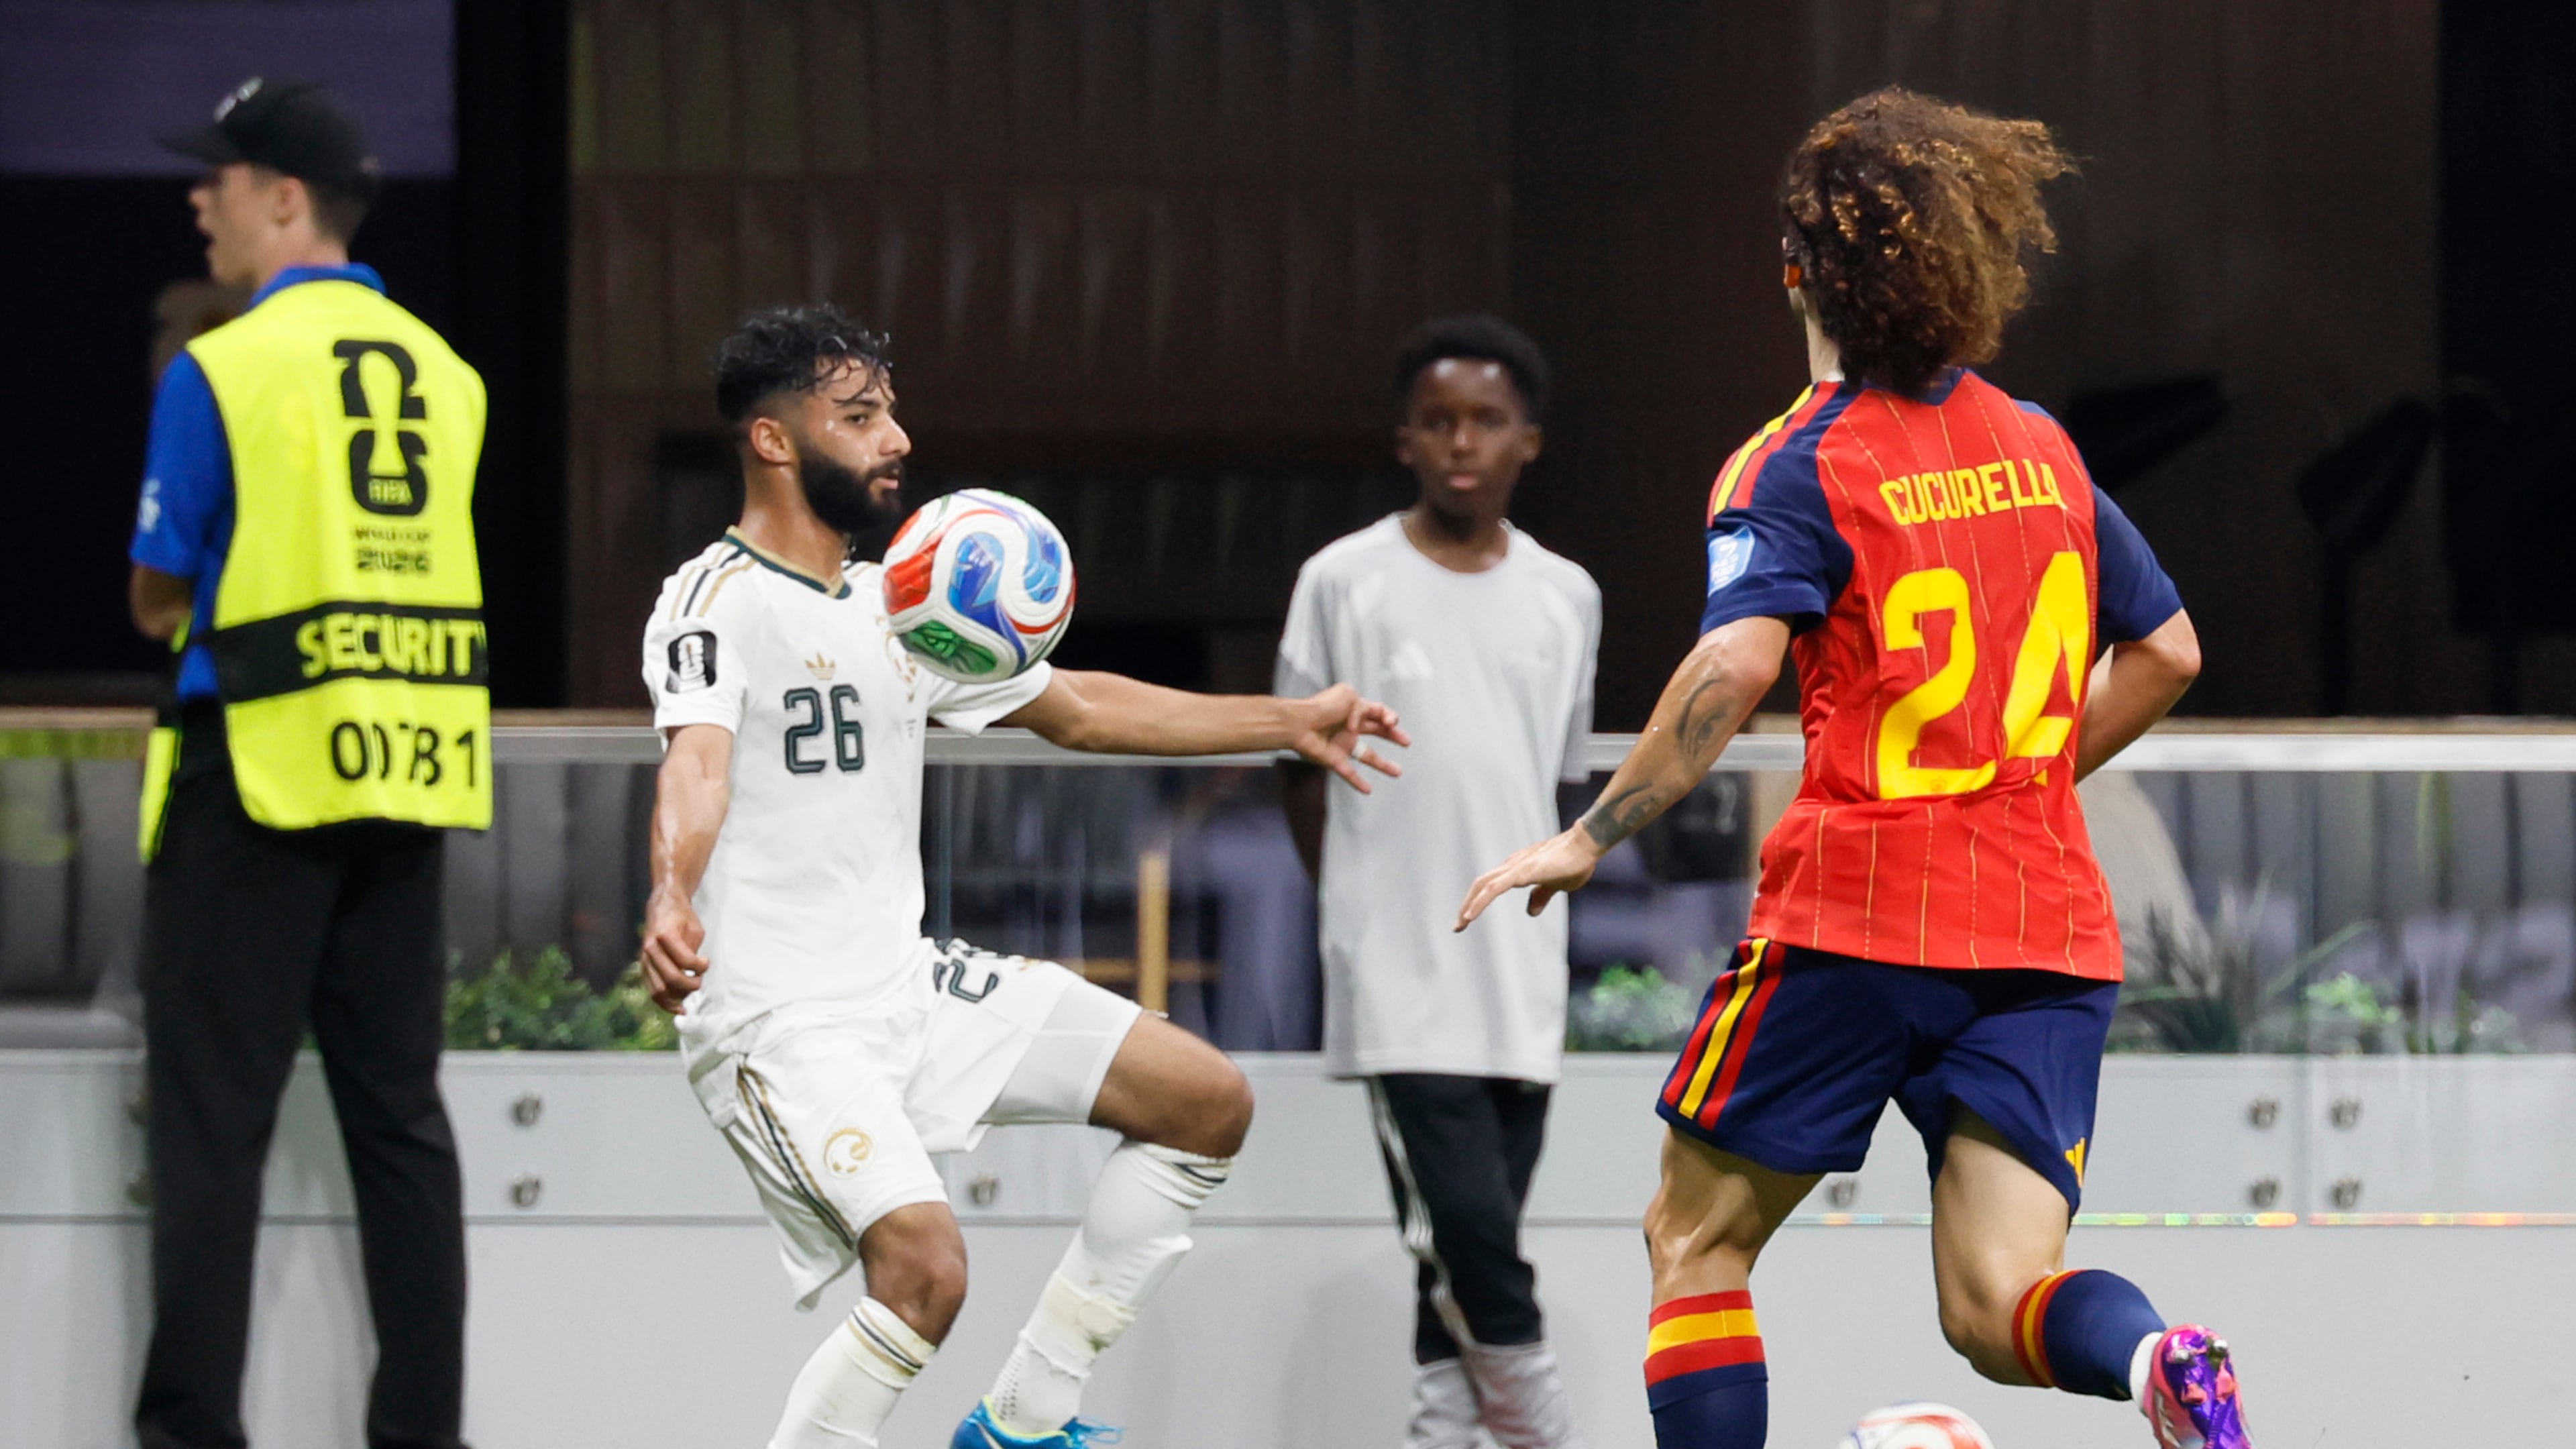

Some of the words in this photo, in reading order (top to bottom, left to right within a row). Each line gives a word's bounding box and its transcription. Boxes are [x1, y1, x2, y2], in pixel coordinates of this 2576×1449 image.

[1878, 458, 2068, 526] CUCURELLA
[1878, 551, 2089, 800] 24
[783, 684, 865, 776] 26
